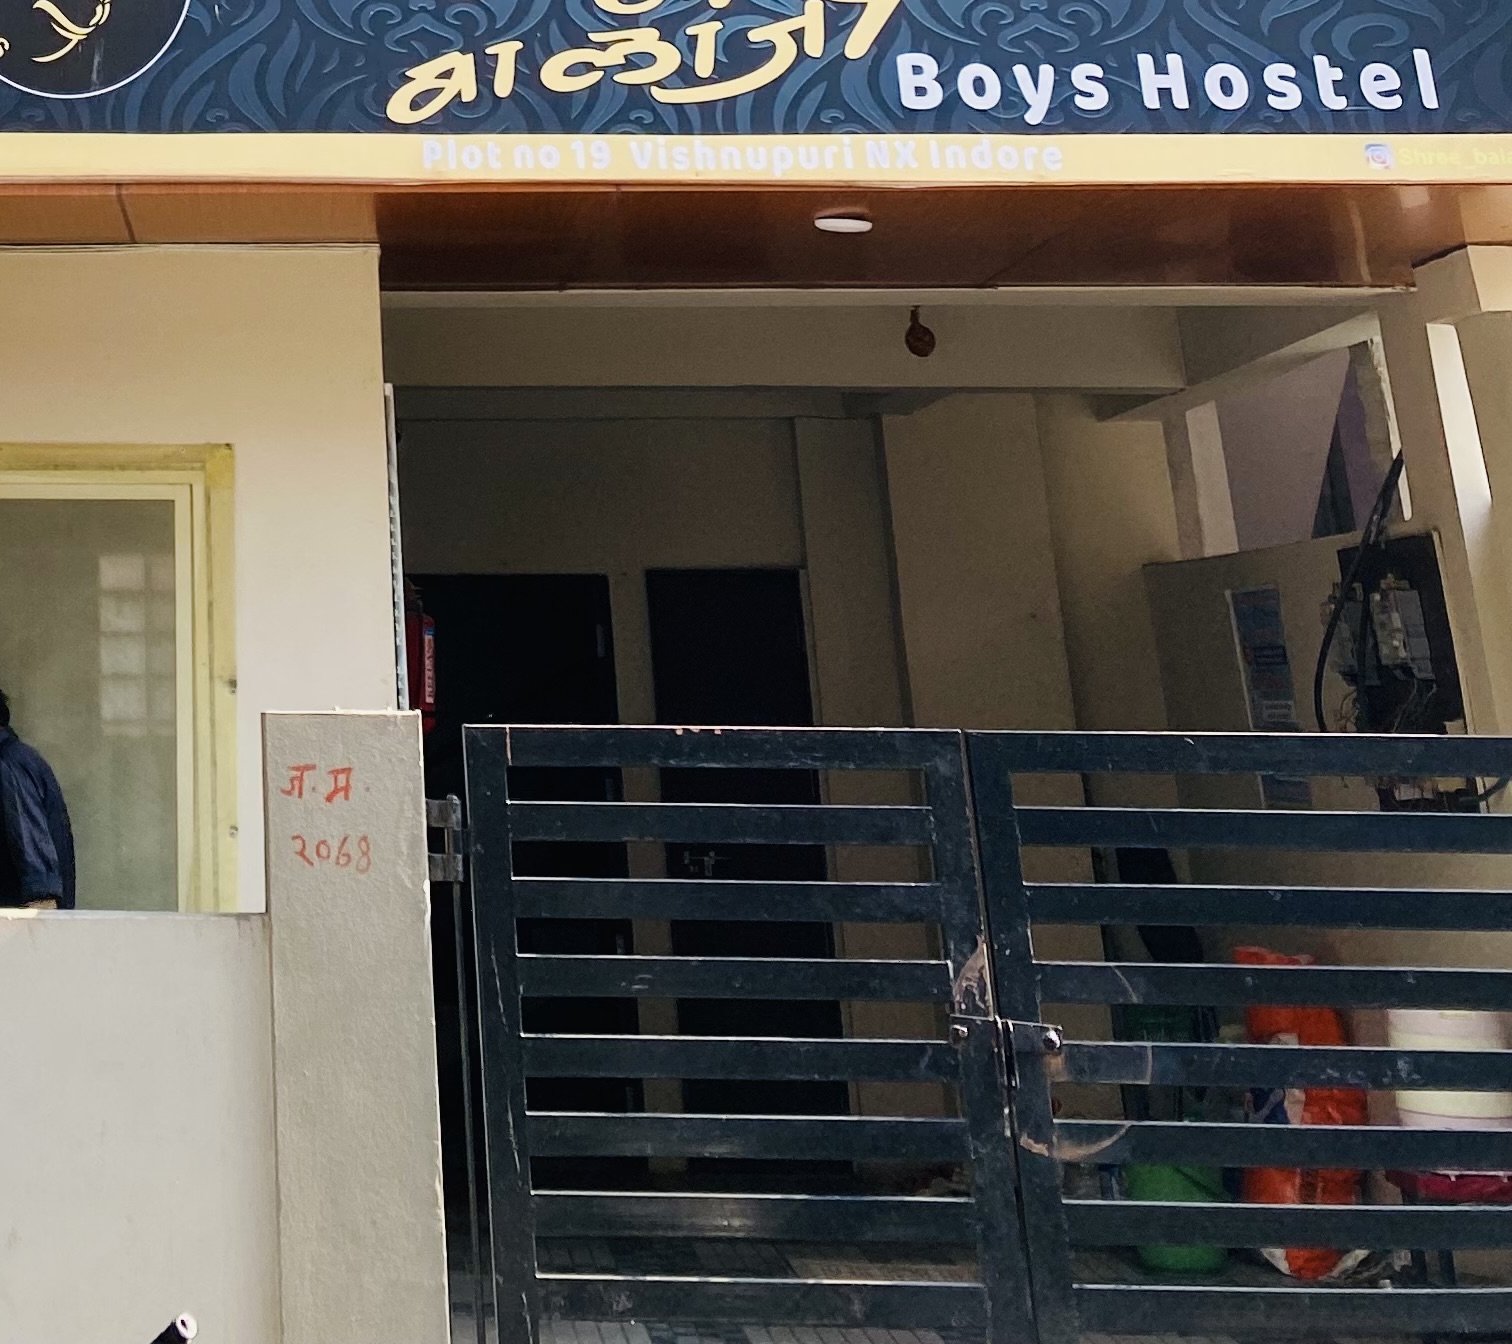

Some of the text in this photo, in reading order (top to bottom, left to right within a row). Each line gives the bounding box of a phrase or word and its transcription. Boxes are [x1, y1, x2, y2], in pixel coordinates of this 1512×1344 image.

[895, 47, 1441, 126] Boys Hostel
[422, 136, 1064, 178] Plot no 19 Vishnupuri NX Indore
